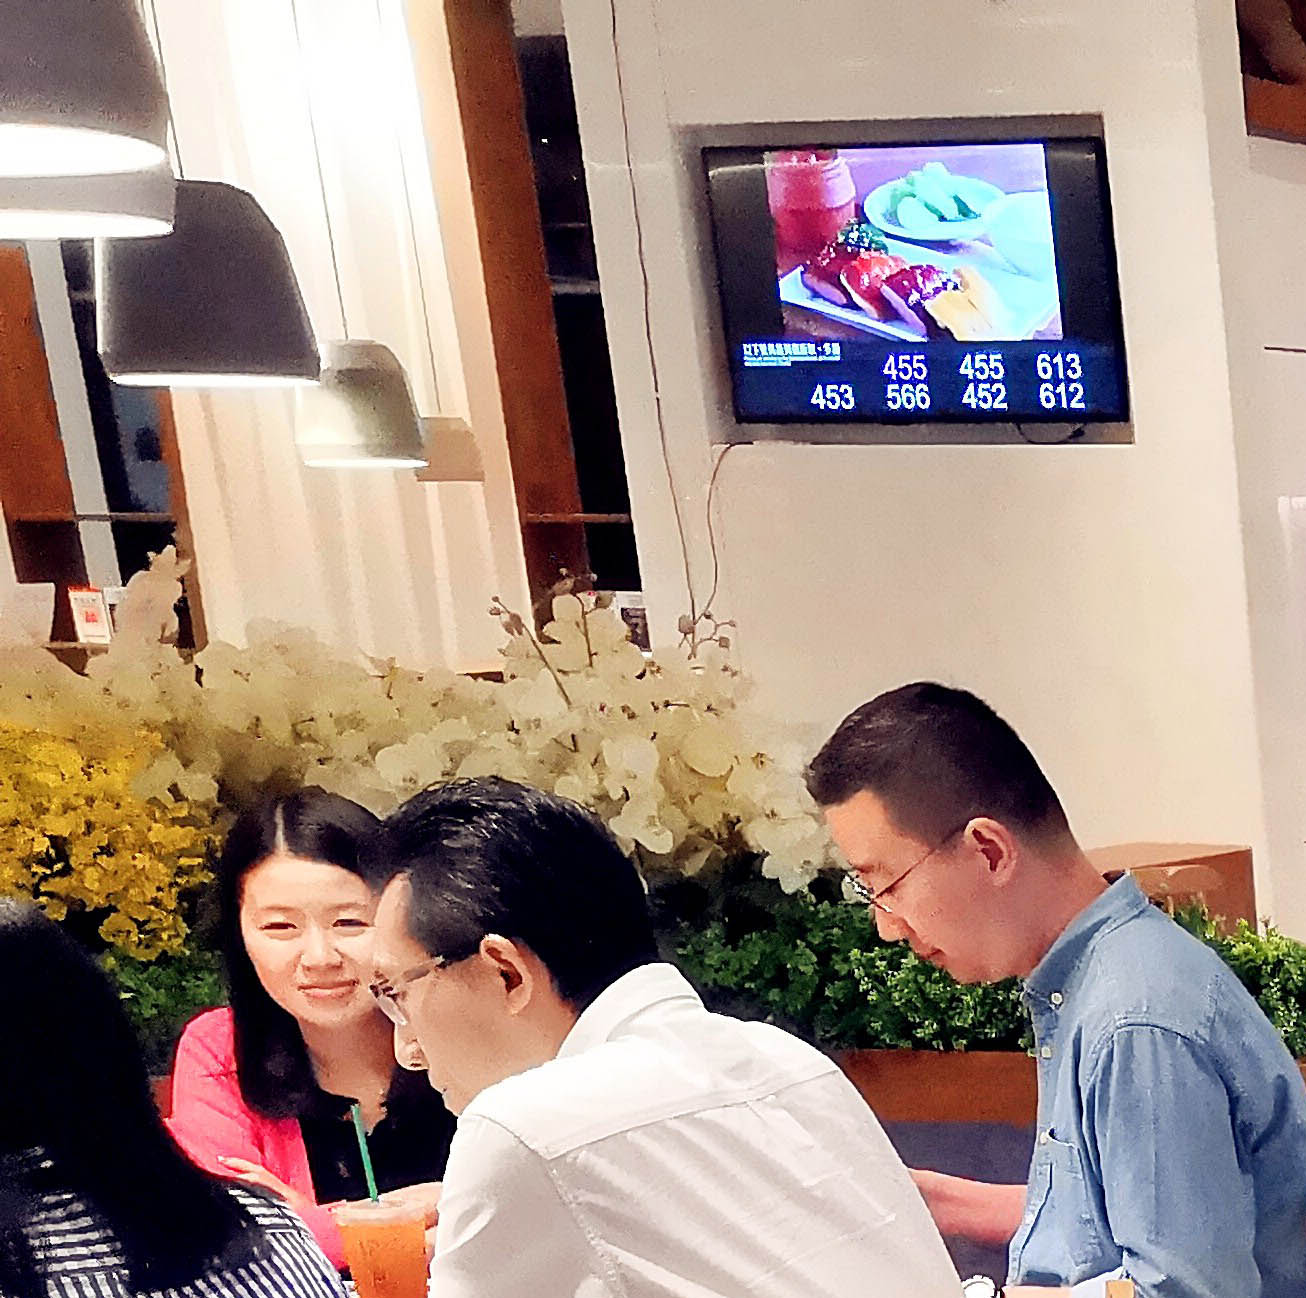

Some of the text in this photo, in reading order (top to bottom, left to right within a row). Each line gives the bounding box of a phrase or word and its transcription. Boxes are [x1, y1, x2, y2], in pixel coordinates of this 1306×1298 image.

[882, 352, 1083, 381] 455 455 613
[810, 381, 1086, 410] 453 566 452 612
